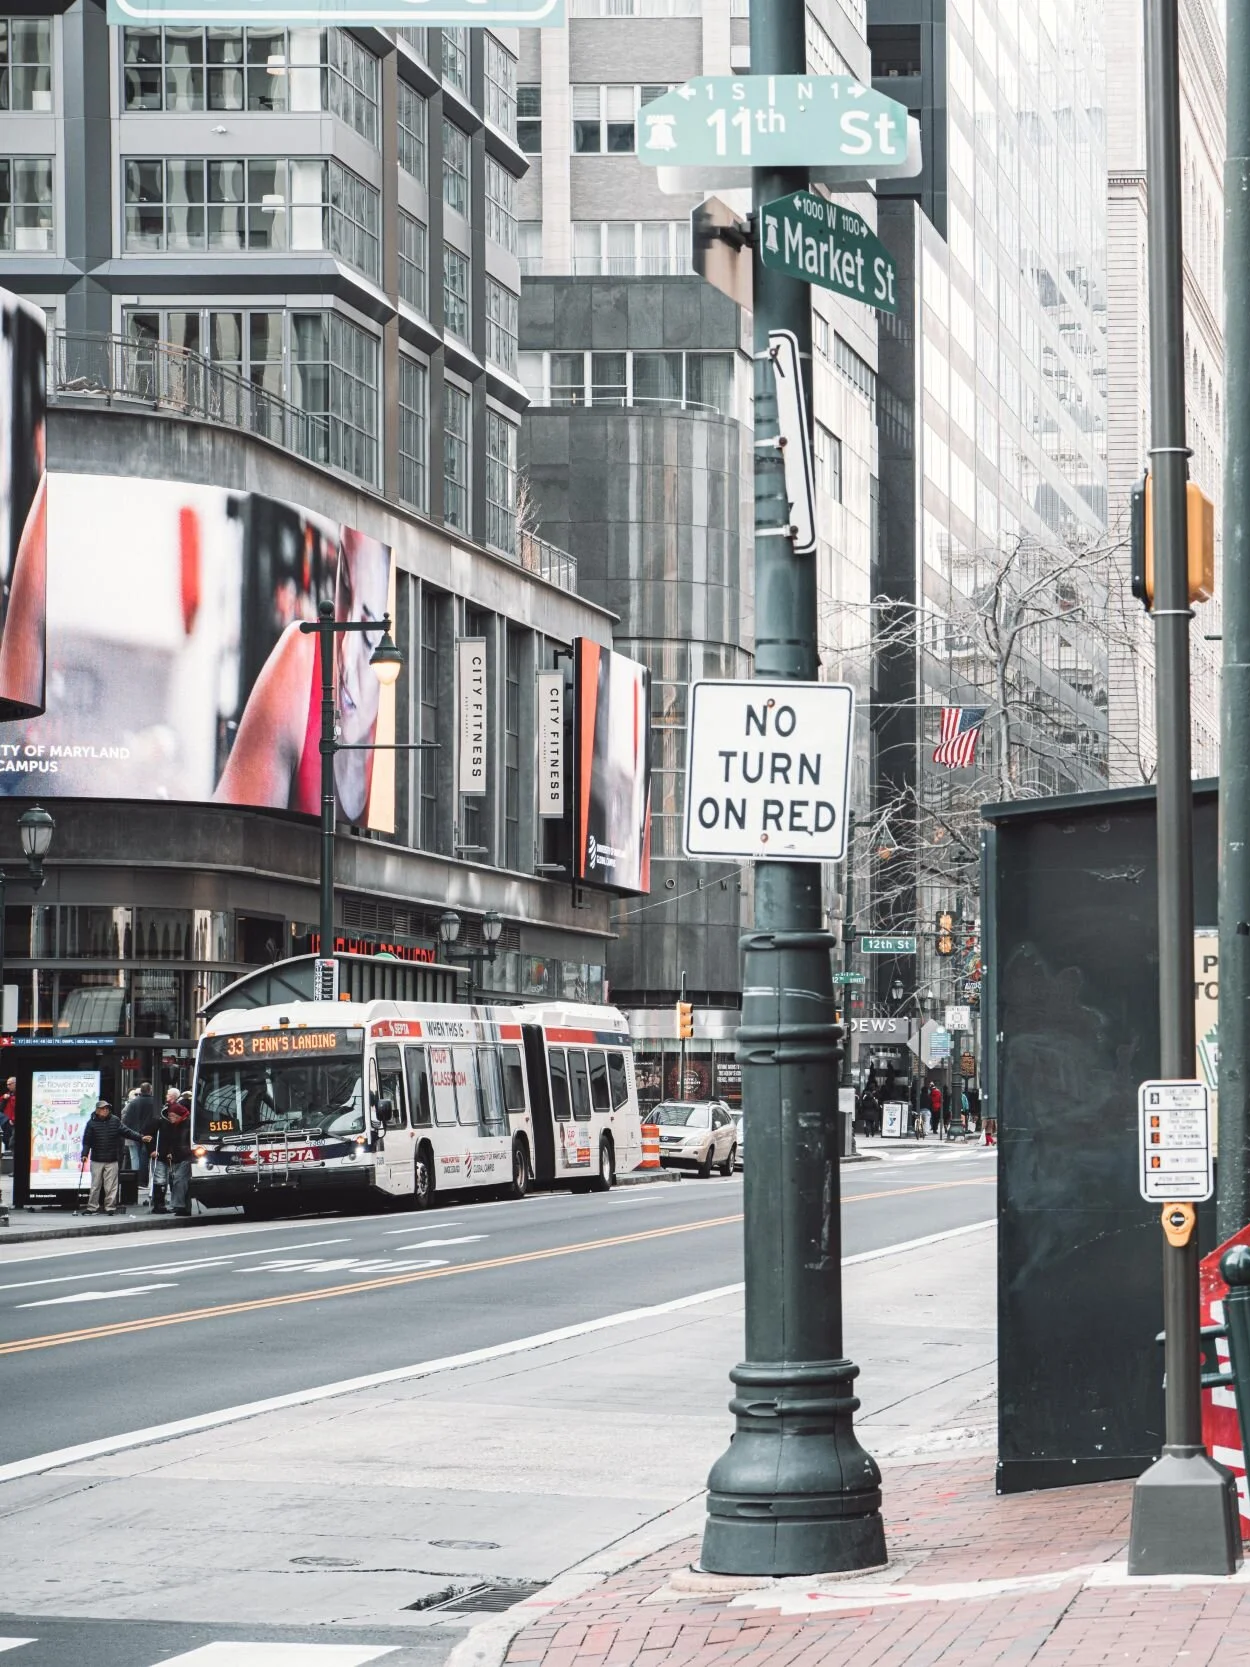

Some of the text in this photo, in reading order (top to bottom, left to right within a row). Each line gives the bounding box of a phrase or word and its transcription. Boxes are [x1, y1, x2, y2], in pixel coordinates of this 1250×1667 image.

[732, 83, 745, 100] S
[797, 82, 813, 99] N
[705, 106, 897, 156] 11th St
[802, 198, 861, 236] 1000 W 1100
[783, 216, 896, 305] Market St
[472, 656, 483, 777] CITY FITNESS
[745, 704, 797, 737] NO
[24, 745, 46, 757] OF
[50, 745, 130, 759] MARYLAND
[550, 688, 560, 800] CITY FITNESS
[718, 751, 822, 785] TURN
[698, 797, 836, 833] ON RED
[868, 939, 910, 949] 12th St
[393, 1022, 410, 1035] SEPTA
[426, 1021, 445, 1037] WHEN
[445, 1022, 456, 1037] THIS
[227, 1033, 336, 1055] 33 PENN'S LANDING
[209, 1120, 233, 1131] 5161
[268, 1149, 315, 1163] SEPTA
